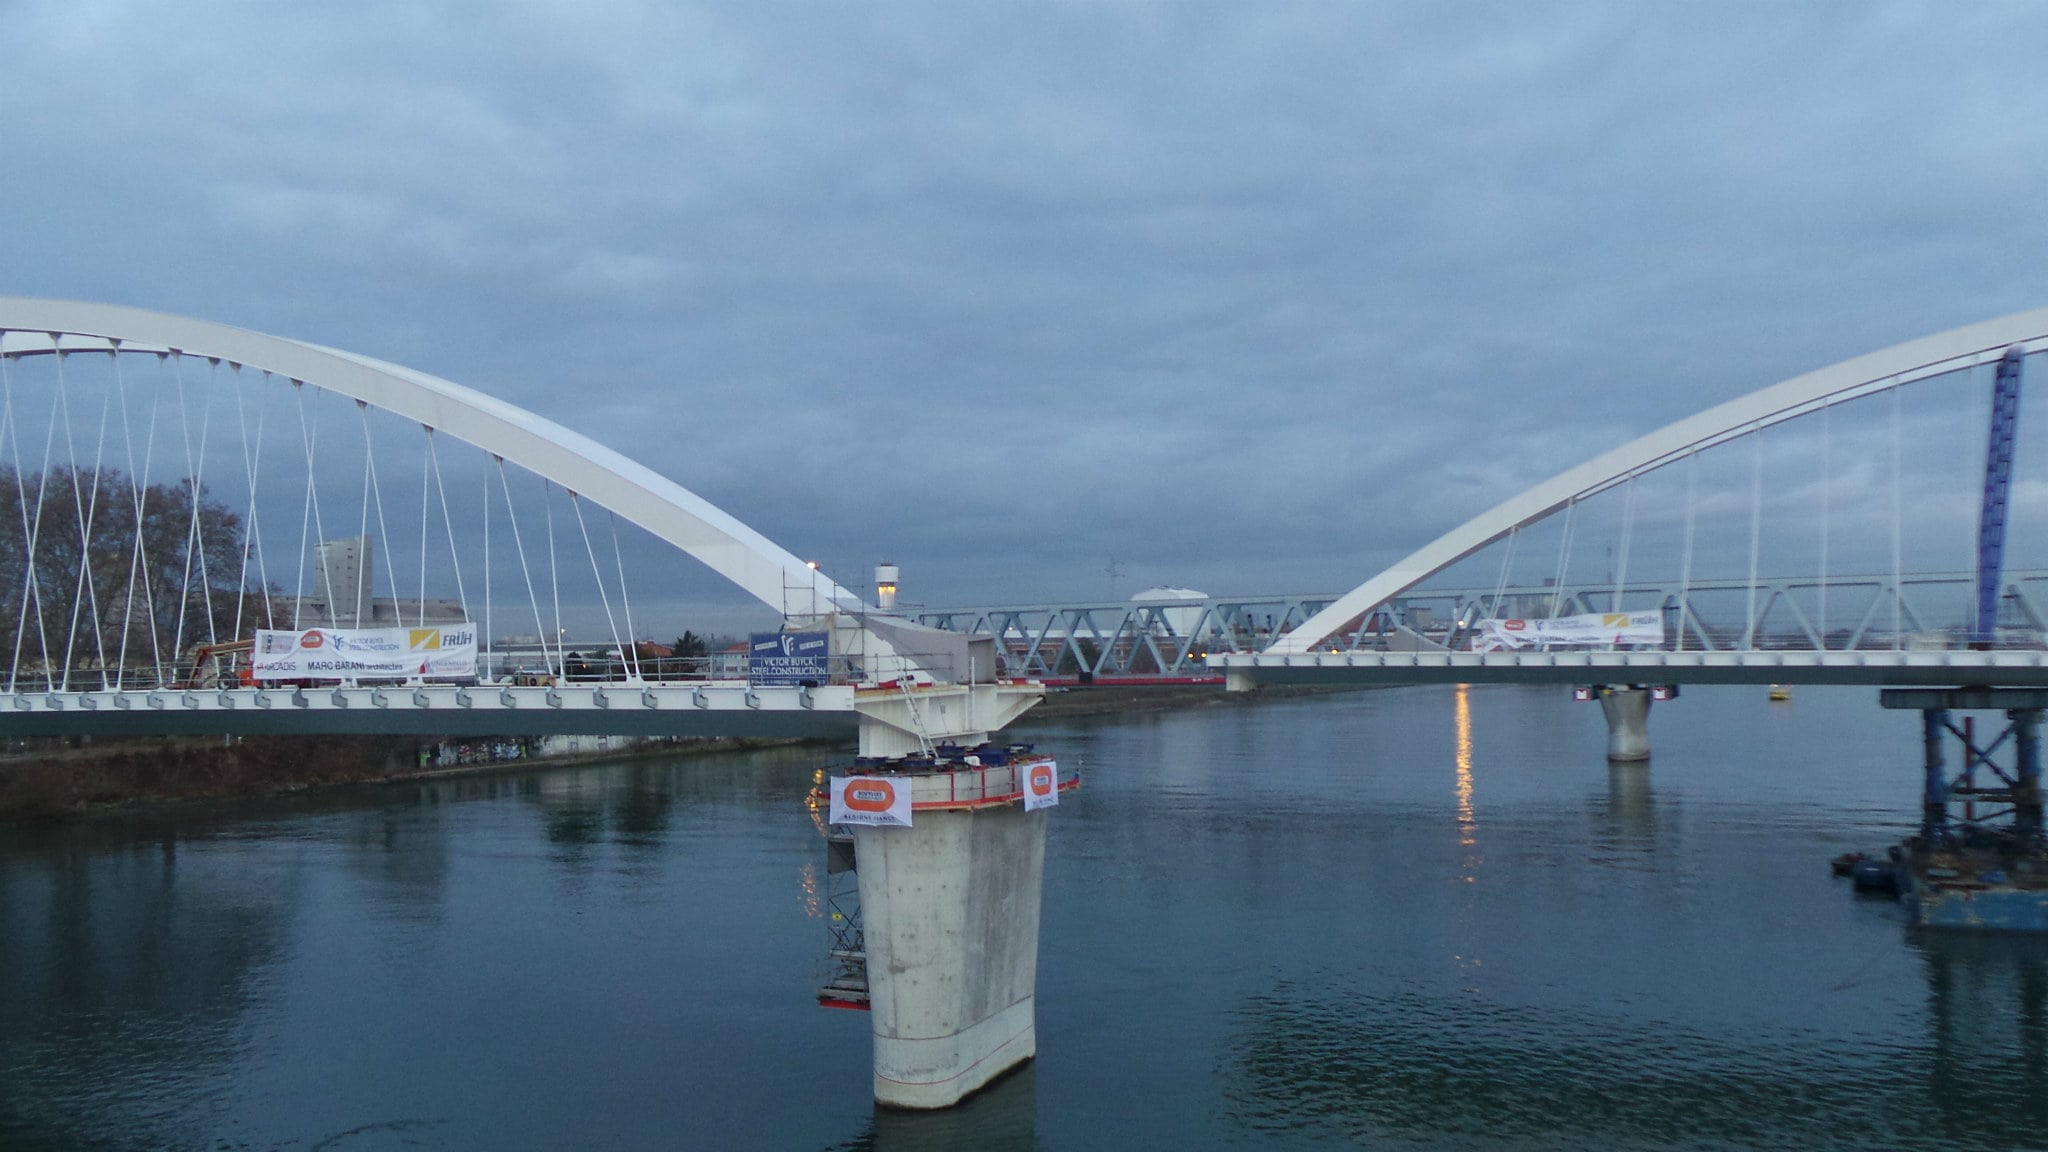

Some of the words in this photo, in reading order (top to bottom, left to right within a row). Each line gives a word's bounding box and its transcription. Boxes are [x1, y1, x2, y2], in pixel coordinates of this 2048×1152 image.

[442, 631, 473, 647] FRÜH
[307, 660, 334, 671] MARC
[764, 657, 790, 667] VICTOR
[751, 666, 770, 676] STEEL
[770, 666, 826, 676] CONSTRUCTION
